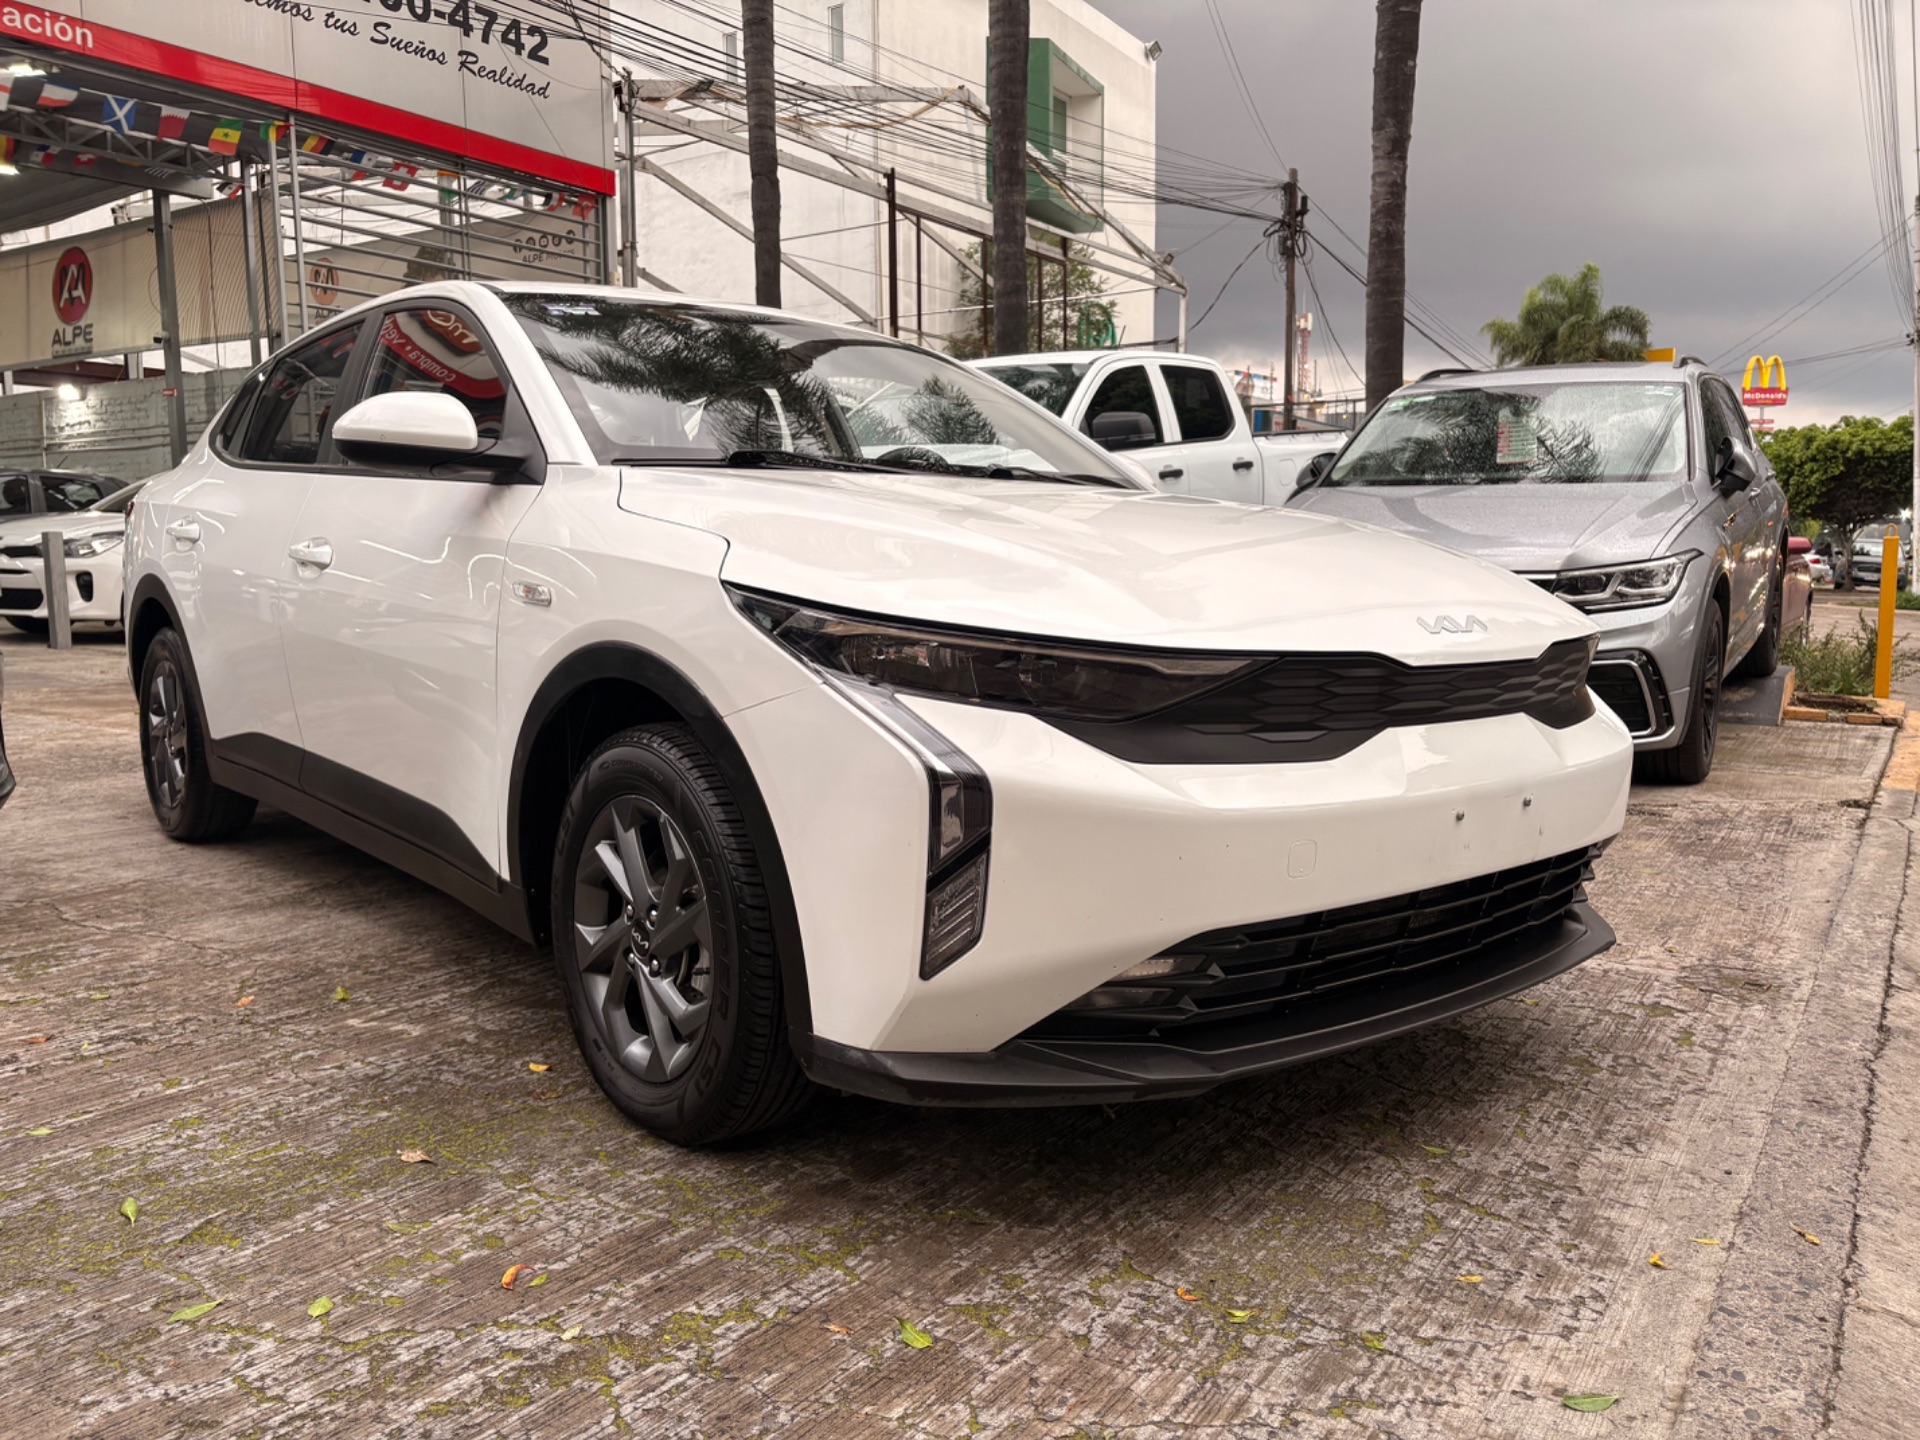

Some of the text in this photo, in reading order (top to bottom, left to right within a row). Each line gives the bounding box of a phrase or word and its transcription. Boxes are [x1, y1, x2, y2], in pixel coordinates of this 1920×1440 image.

[2, 7, 93, 48] ación
[323, 12, 360, 36] tus
[369, 21, 448, 65] Sueños
[457, 50, 550, 99] Realidad
[52, 323, 94, 348] ALPE
